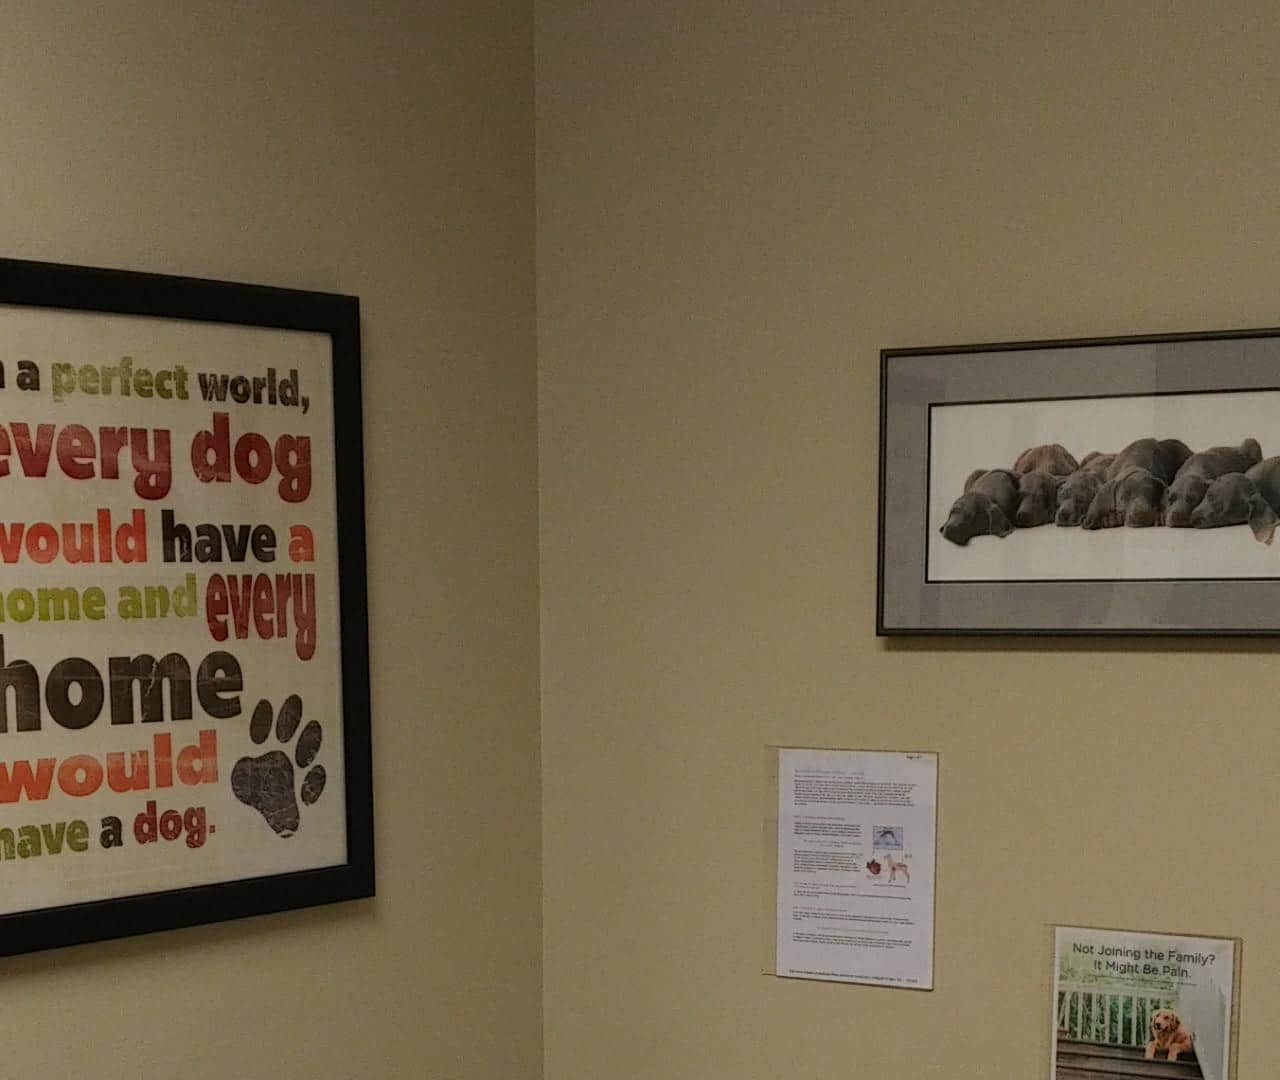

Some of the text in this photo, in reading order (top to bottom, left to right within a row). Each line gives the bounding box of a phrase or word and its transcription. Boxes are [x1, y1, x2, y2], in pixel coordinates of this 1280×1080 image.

[16, 359, 40, 392] a
[51, 357, 189, 402] perfect
[198, 367, 310, 414] world,
[190, 411, 312, 503] dog
[161, 509, 277, 563] have
[289, 524, 315, 562] a
[118, 573, 198, 620] and
[205, 572, 317, 661] every
[99, 815, 123, 848] a
[133, 800, 216, 848] dog.
[1072, 943, 1216, 967] Not Joining the Family?
[1094, 959, 1102, 971] It
[1106, 961, 1140, 975] Might
[1143, 963, 1160, 976] Be
